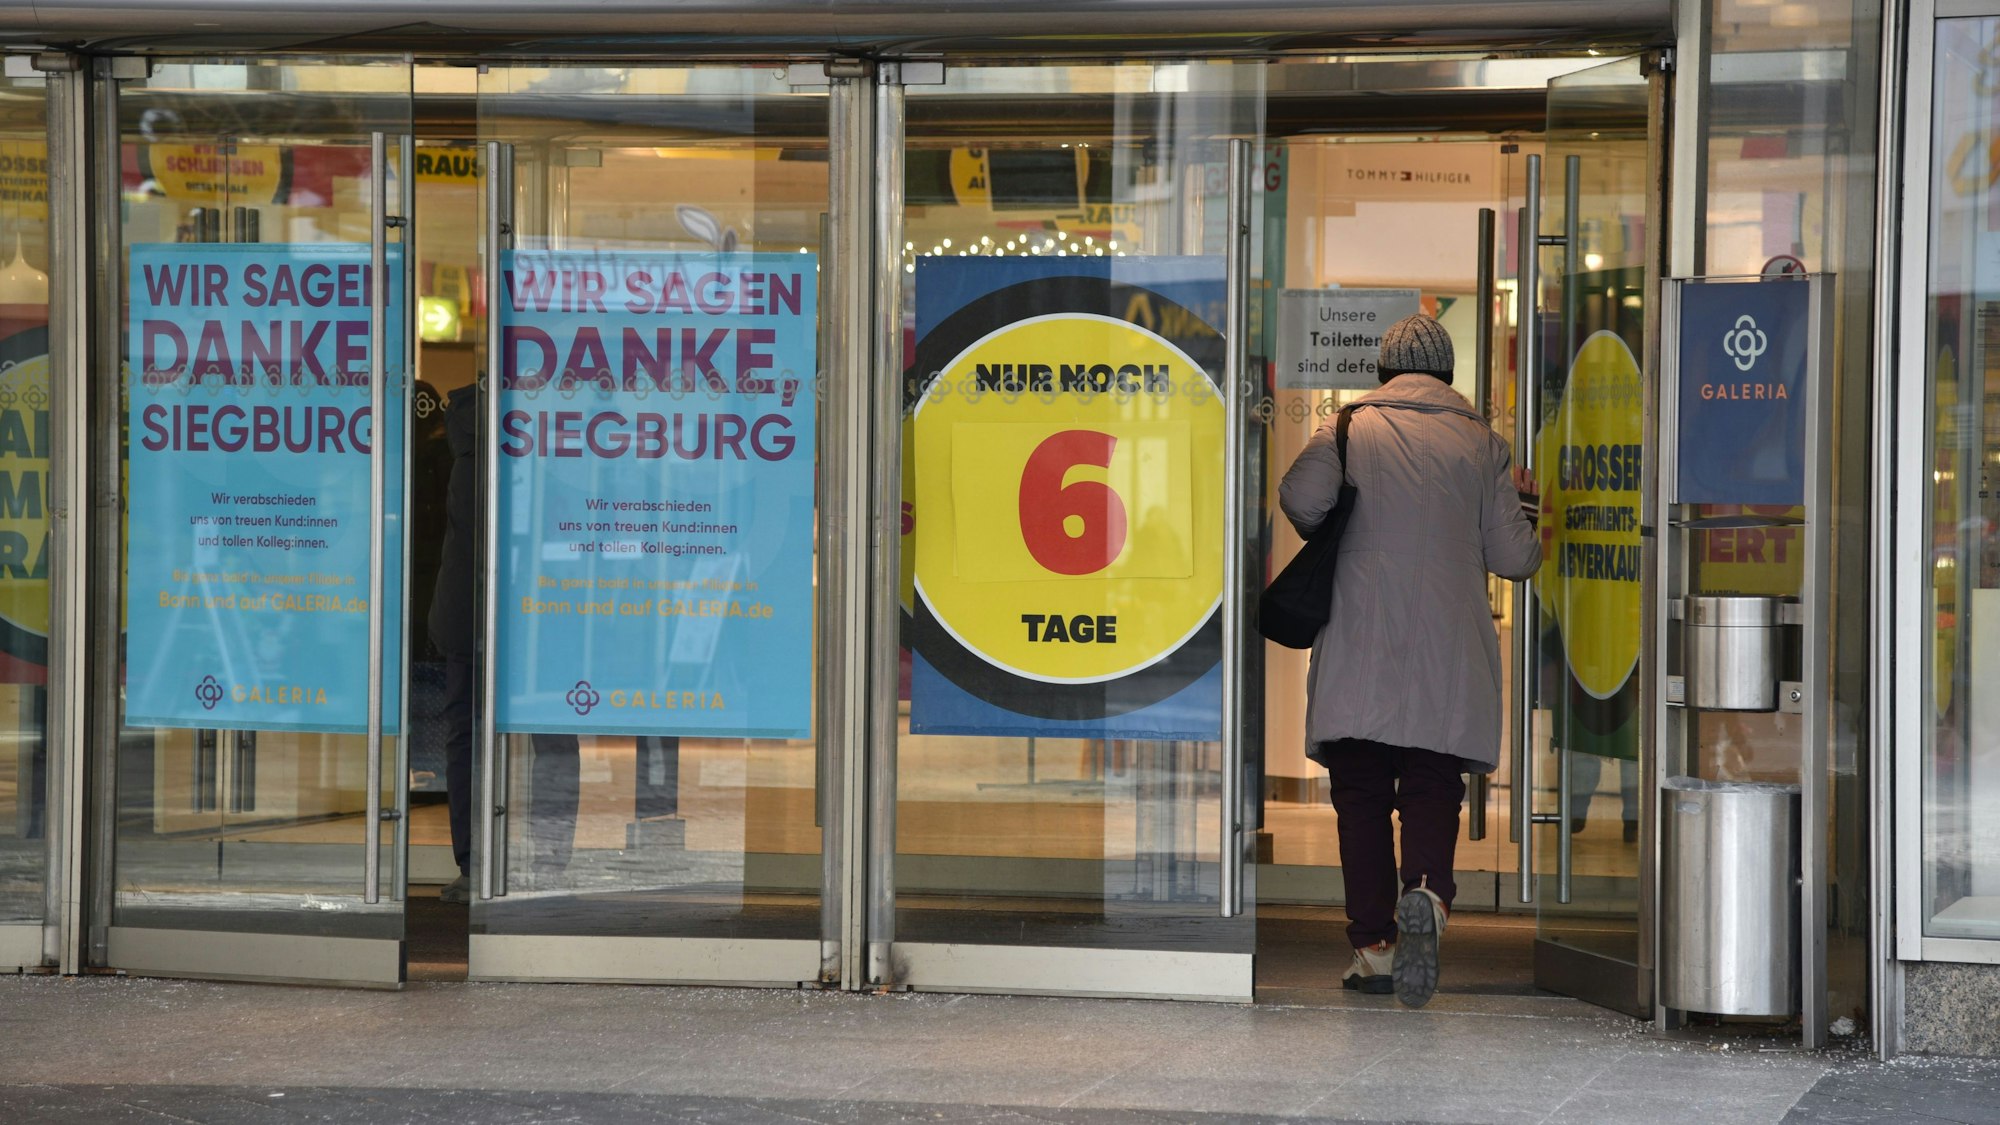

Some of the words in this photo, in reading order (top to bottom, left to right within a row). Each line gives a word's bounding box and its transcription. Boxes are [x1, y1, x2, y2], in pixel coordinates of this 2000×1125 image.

[1347, 168, 1397, 181] TOMMY
[1415, 171, 1471, 184] HILFIGER
[143, 264, 229, 307] WIR
[503, 270, 608, 313] WIR
[624, 271, 801, 316] SAGEN
[1320, 307, 1376, 322] Unsere
[143, 320, 389, 386] DANKE
[503, 325, 799, 407] DANKE,
[1298, 358, 1329, 373] sind
[975, 364, 1052, 392] NUR
[1059, 364, 1169, 393] NOCH
[1701, 384, 1788, 400] GALERIA
[500, 410, 796, 462] SIEGBURG
[211, 492, 230, 505] Wir
[233, 493, 316, 506] verabschieden
[585, 499, 608, 511] Wir
[612, 499, 711, 513] verabschieden
[1018, 429, 1128, 576] 6
[190, 516, 209, 526] uns
[212, 516, 231, 526] von
[235, 515, 271, 527] treuen
[275, 515, 338, 528] Kund:innen
[559, 521, 582, 532] uns
[586, 521, 610, 532] von
[614, 521, 658, 533] treuen
[662, 520, 738, 534] Kund:innen
[1565, 505, 1637, 532] SORTIMENTS-
[198, 535, 219, 546] und
[222, 535, 253, 547] tollen
[257, 536, 329, 550] Kolleg:innen.
[569, 541, 594, 553] und
[599, 541, 636, 553] tollen
[640, 541, 727, 557] Kolleg:innen.
[598, 577, 628, 589] bald
[160, 591, 200, 608] Bonn
[204, 592, 235, 609] und
[240, 593, 267, 610] auf
[271, 593, 368, 613] GALERIA.de
[521, 597, 571, 614] Bonn
[575, 597, 614, 615] und
[619, 598, 651, 616] auf
[657, 599, 774, 619] GALERIA.de
[1021, 614, 1117, 643] TAGE
[231, 685, 328, 705] GALERIA
[609, 689, 725, 710] GALERIA
